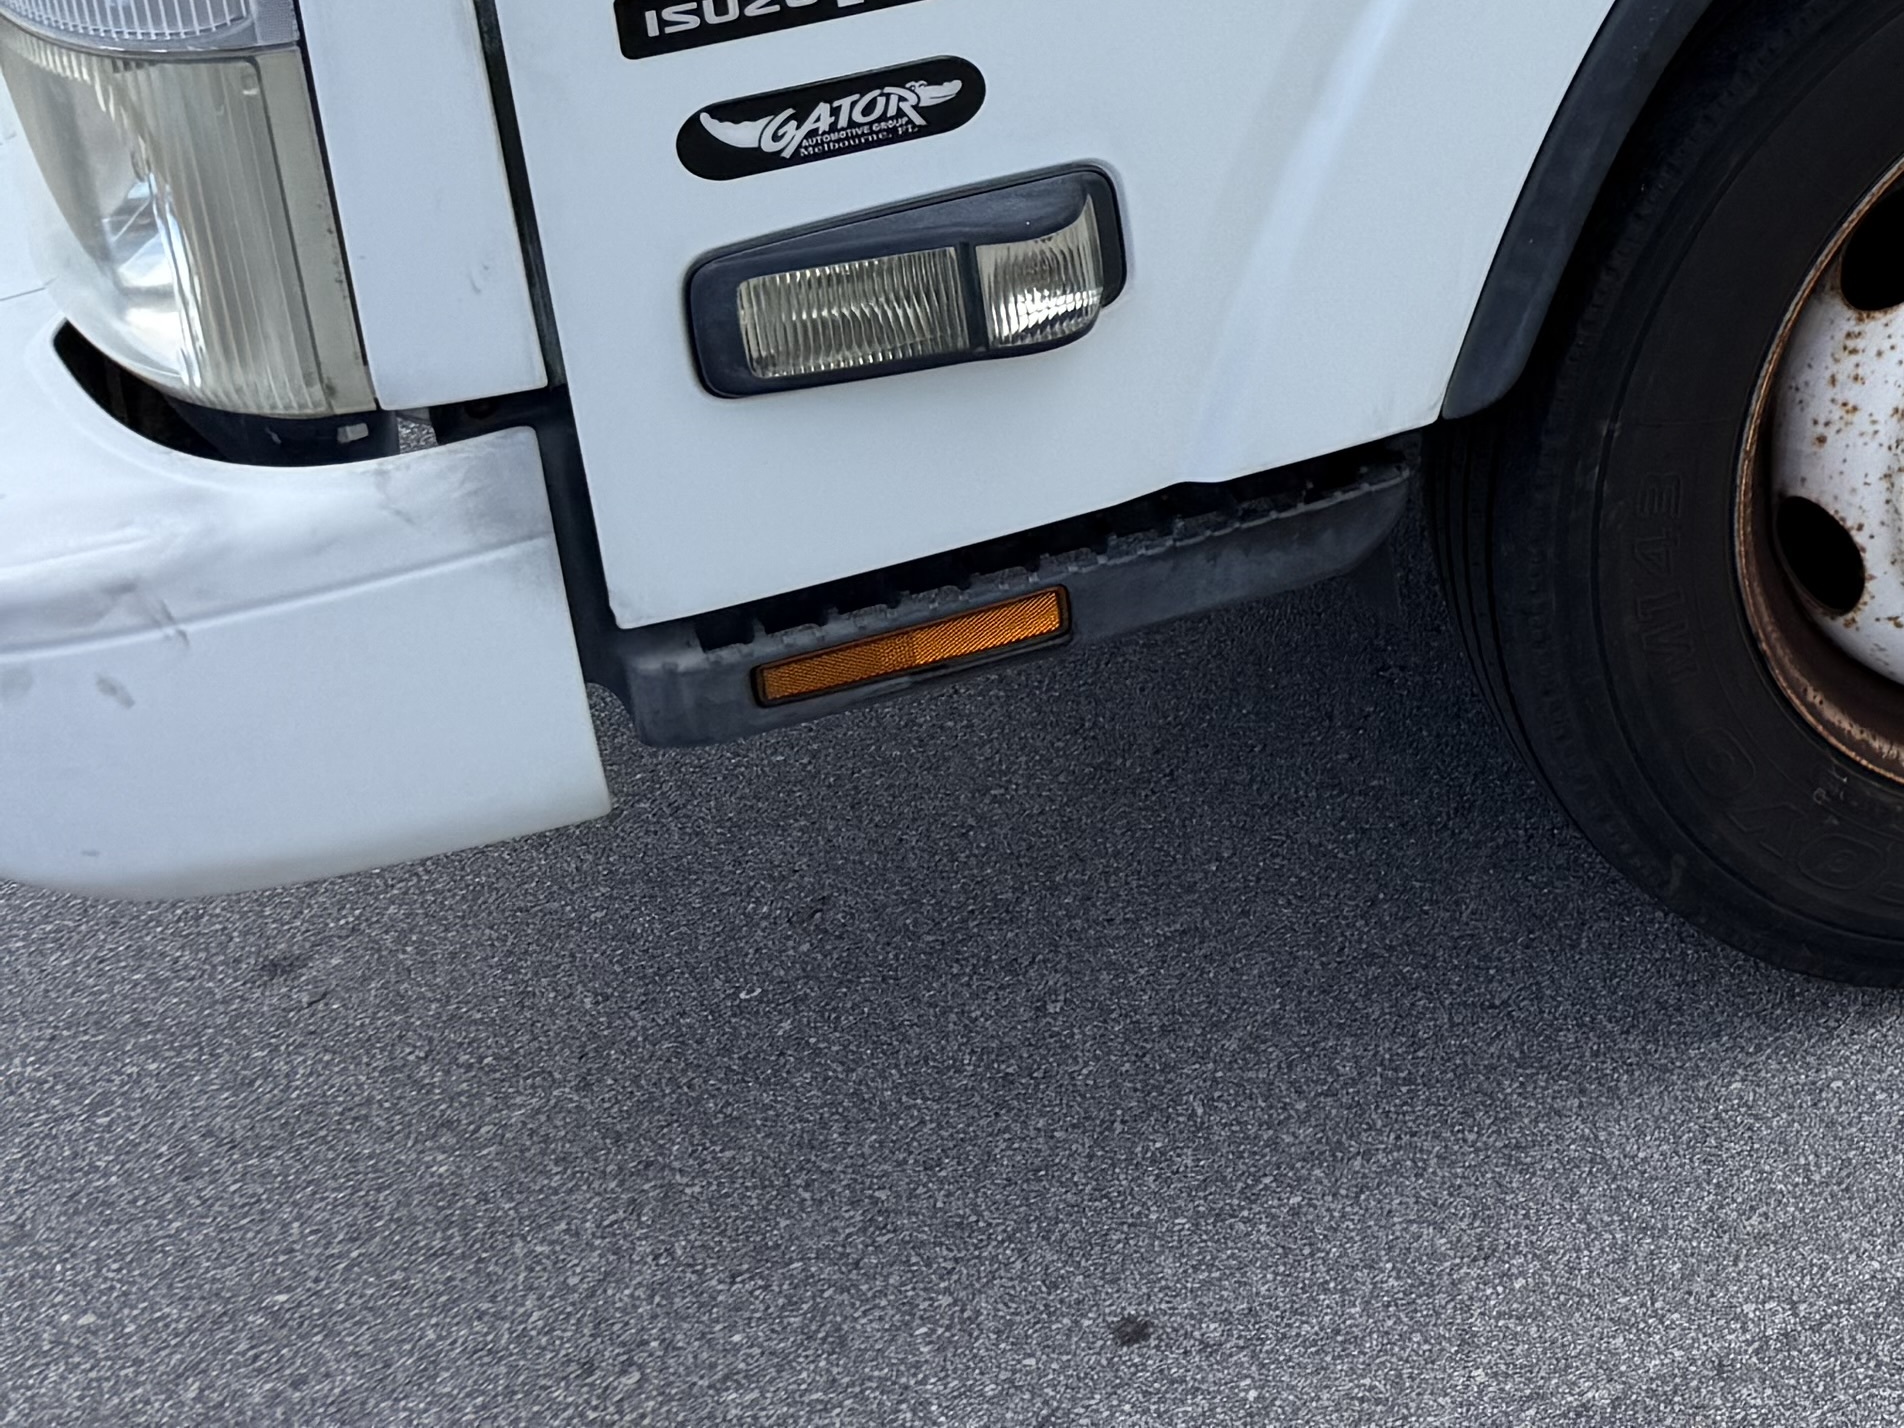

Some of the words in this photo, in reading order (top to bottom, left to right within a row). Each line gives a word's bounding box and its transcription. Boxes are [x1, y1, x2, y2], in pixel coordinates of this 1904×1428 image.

[759, 86, 928, 159] GATOR
[801, 125, 871, 147] AUTOMOTIVE
[871, 116, 911, 134] GROUP
